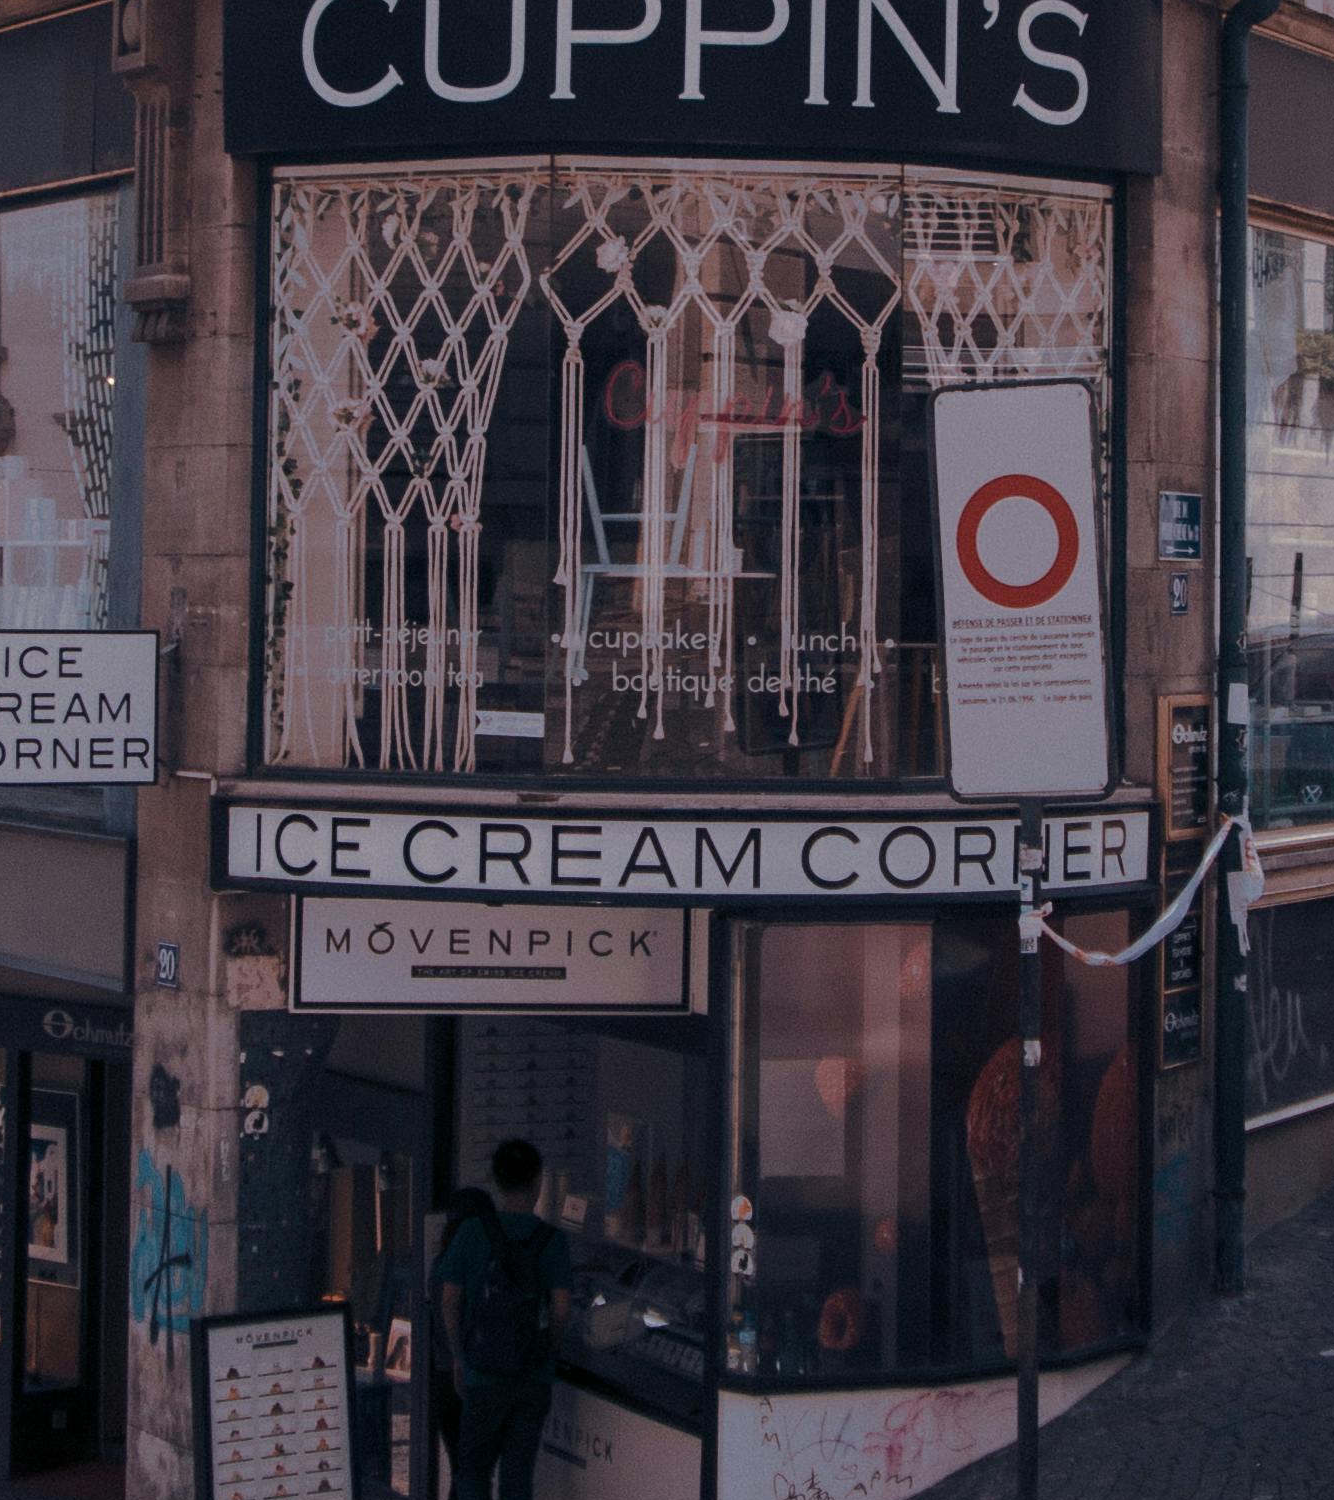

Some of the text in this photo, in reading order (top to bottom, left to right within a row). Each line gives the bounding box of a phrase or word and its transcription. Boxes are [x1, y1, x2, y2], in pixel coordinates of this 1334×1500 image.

[1173, 578, 1187, 608] 20
[985, 617, 996, 627] DE
[997, 616, 1023, 627] PASSER
[1025, 616, 1034, 626] ET
[1036, 615, 1045, 626] DE
[1047, 614, 1092, 625] STATIONNER
[784, 622, 856, 652] unch
[3, 645, 84, 679] ICE
[612, 661, 837, 701] boutique de thé
[255, 813, 372, 879] ICE
[403, 818, 762, 889] CREAM
[159, 948, 175, 980] 20
